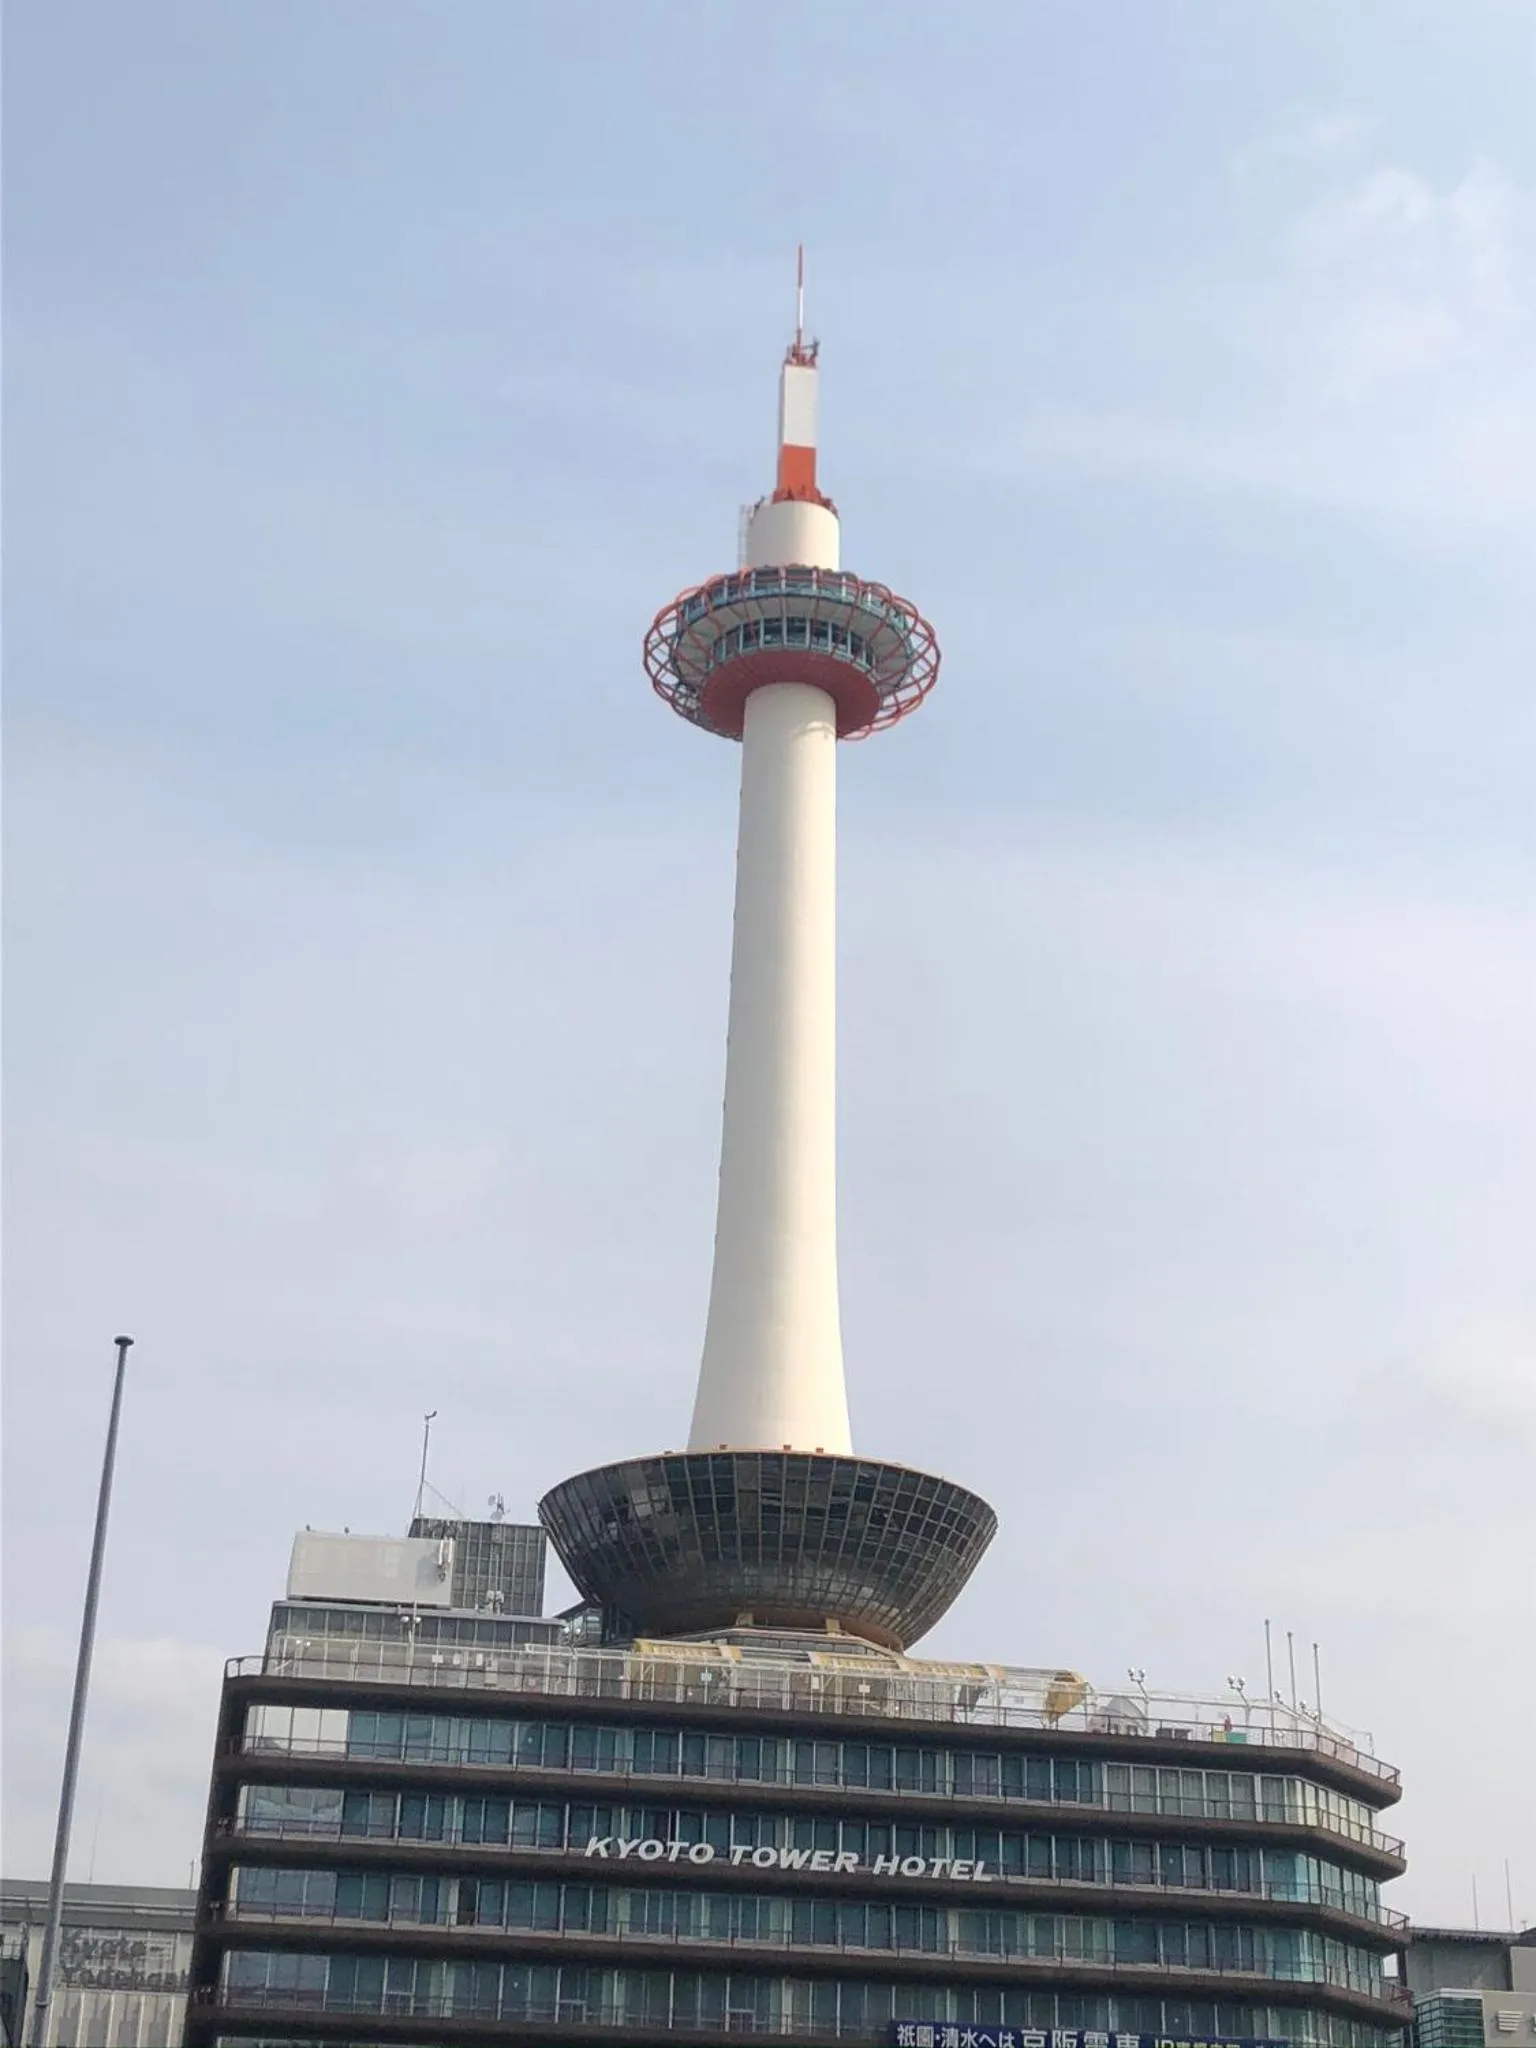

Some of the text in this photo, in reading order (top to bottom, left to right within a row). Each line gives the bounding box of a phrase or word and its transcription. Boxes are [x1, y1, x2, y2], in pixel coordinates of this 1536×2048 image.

[585, 1836, 993, 1883] KYOTO TOWER HOTEL
